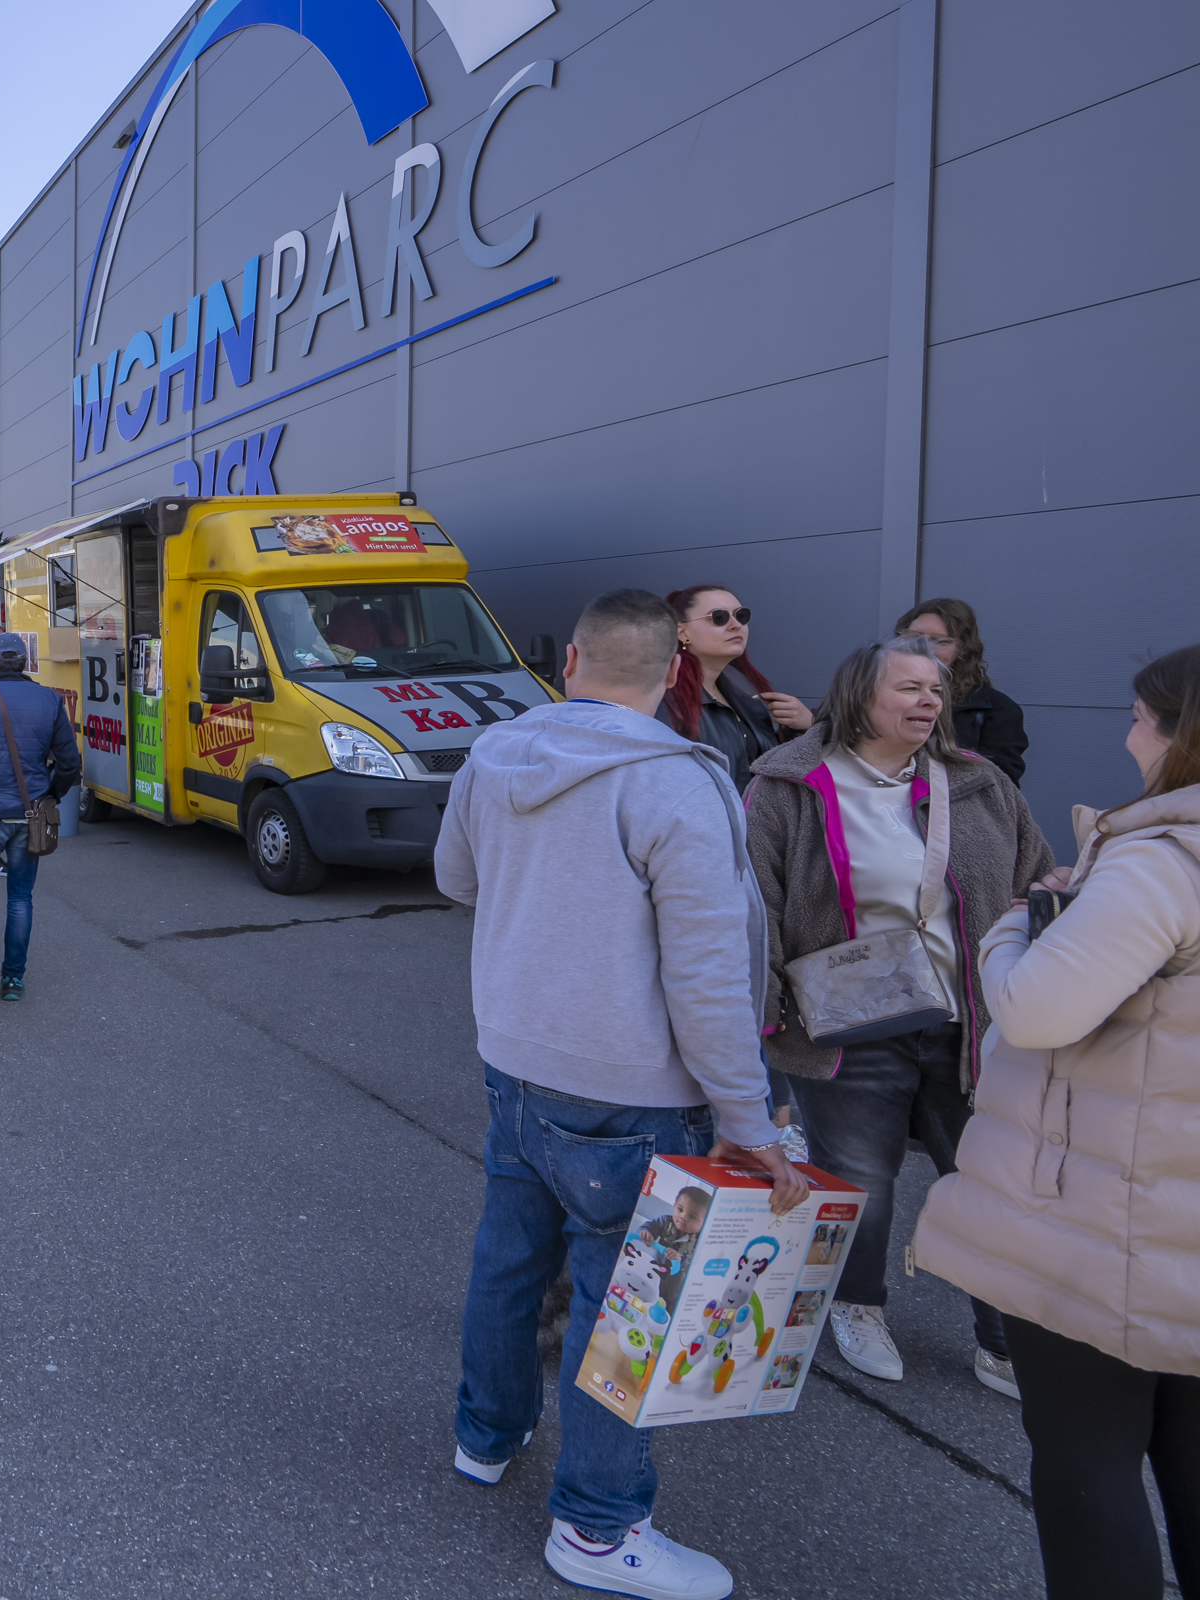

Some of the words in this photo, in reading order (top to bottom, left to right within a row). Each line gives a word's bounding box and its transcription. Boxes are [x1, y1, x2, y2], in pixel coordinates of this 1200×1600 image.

[73, 59, 555, 463] WOHNPARC
[332, 520, 410, 536] Langos
[373, 682, 443, 703] Mi
[198, 708, 253, 753] ORIGINAL
[401, 708, 472, 732] Ka
[87, 714, 122, 756] CREW
[136, 723, 157, 747] MAL
[136, 751, 157, 775] ANDERS
[219, 762, 238, 777] 2015
[135, 779, 152, 795] FRESH
